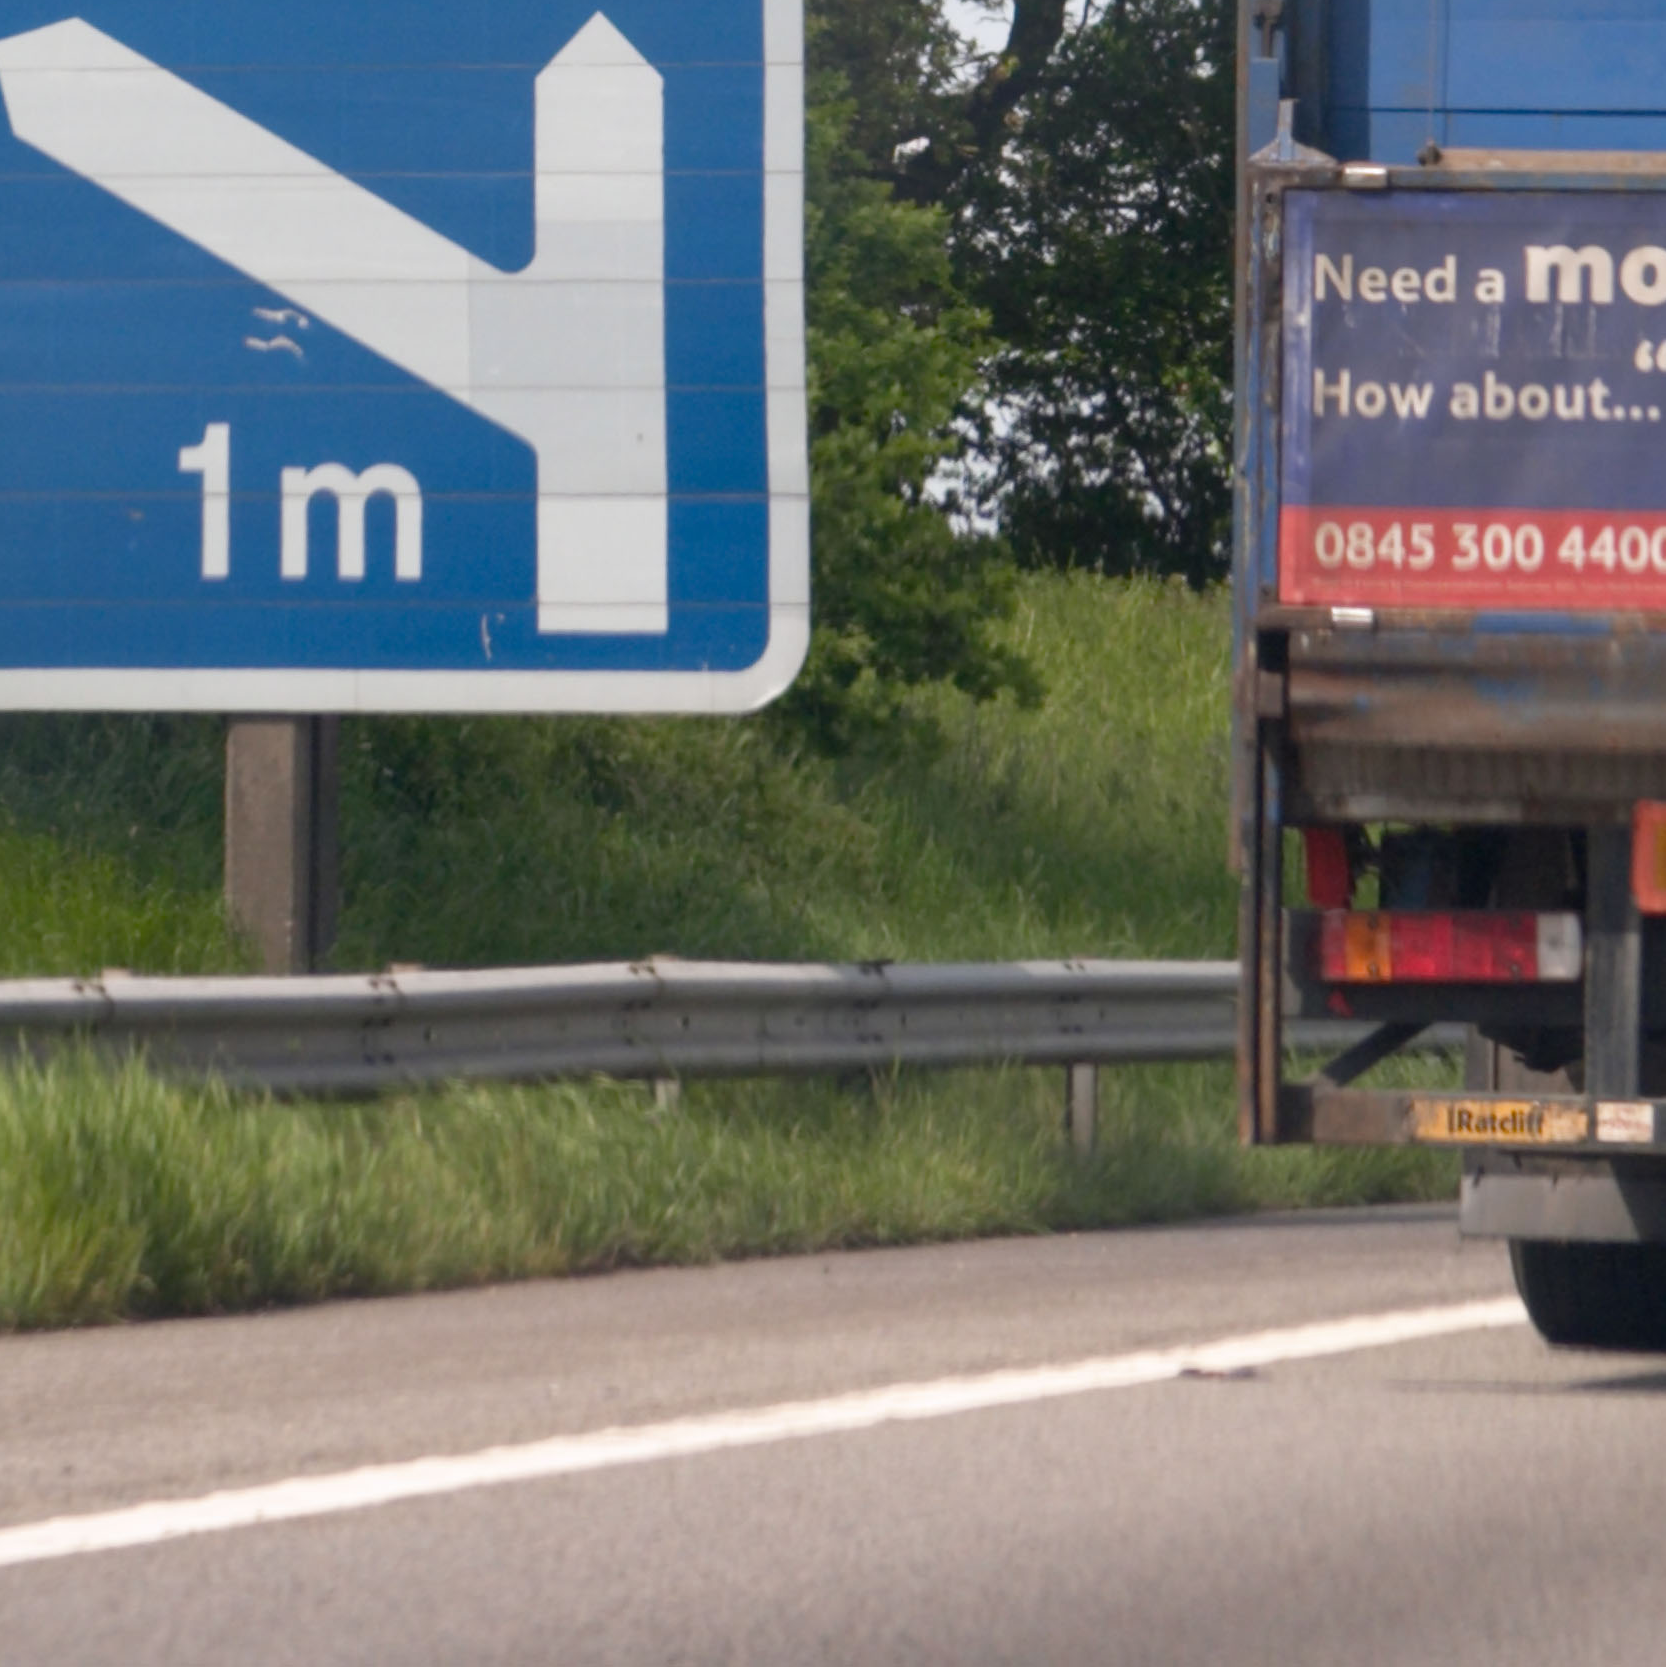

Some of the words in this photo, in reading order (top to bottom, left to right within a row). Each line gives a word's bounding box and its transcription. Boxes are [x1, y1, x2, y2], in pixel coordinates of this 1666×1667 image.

[1314, 253, 1458, 303] Need
[1475, 267, 1506, 304] a
[1313, 368, 1433, 420] How
[1449, 370, 1662, 422] about...
[1315, 522, 1435, 570] 0845
[1451, 523, 1543, 572] 300
